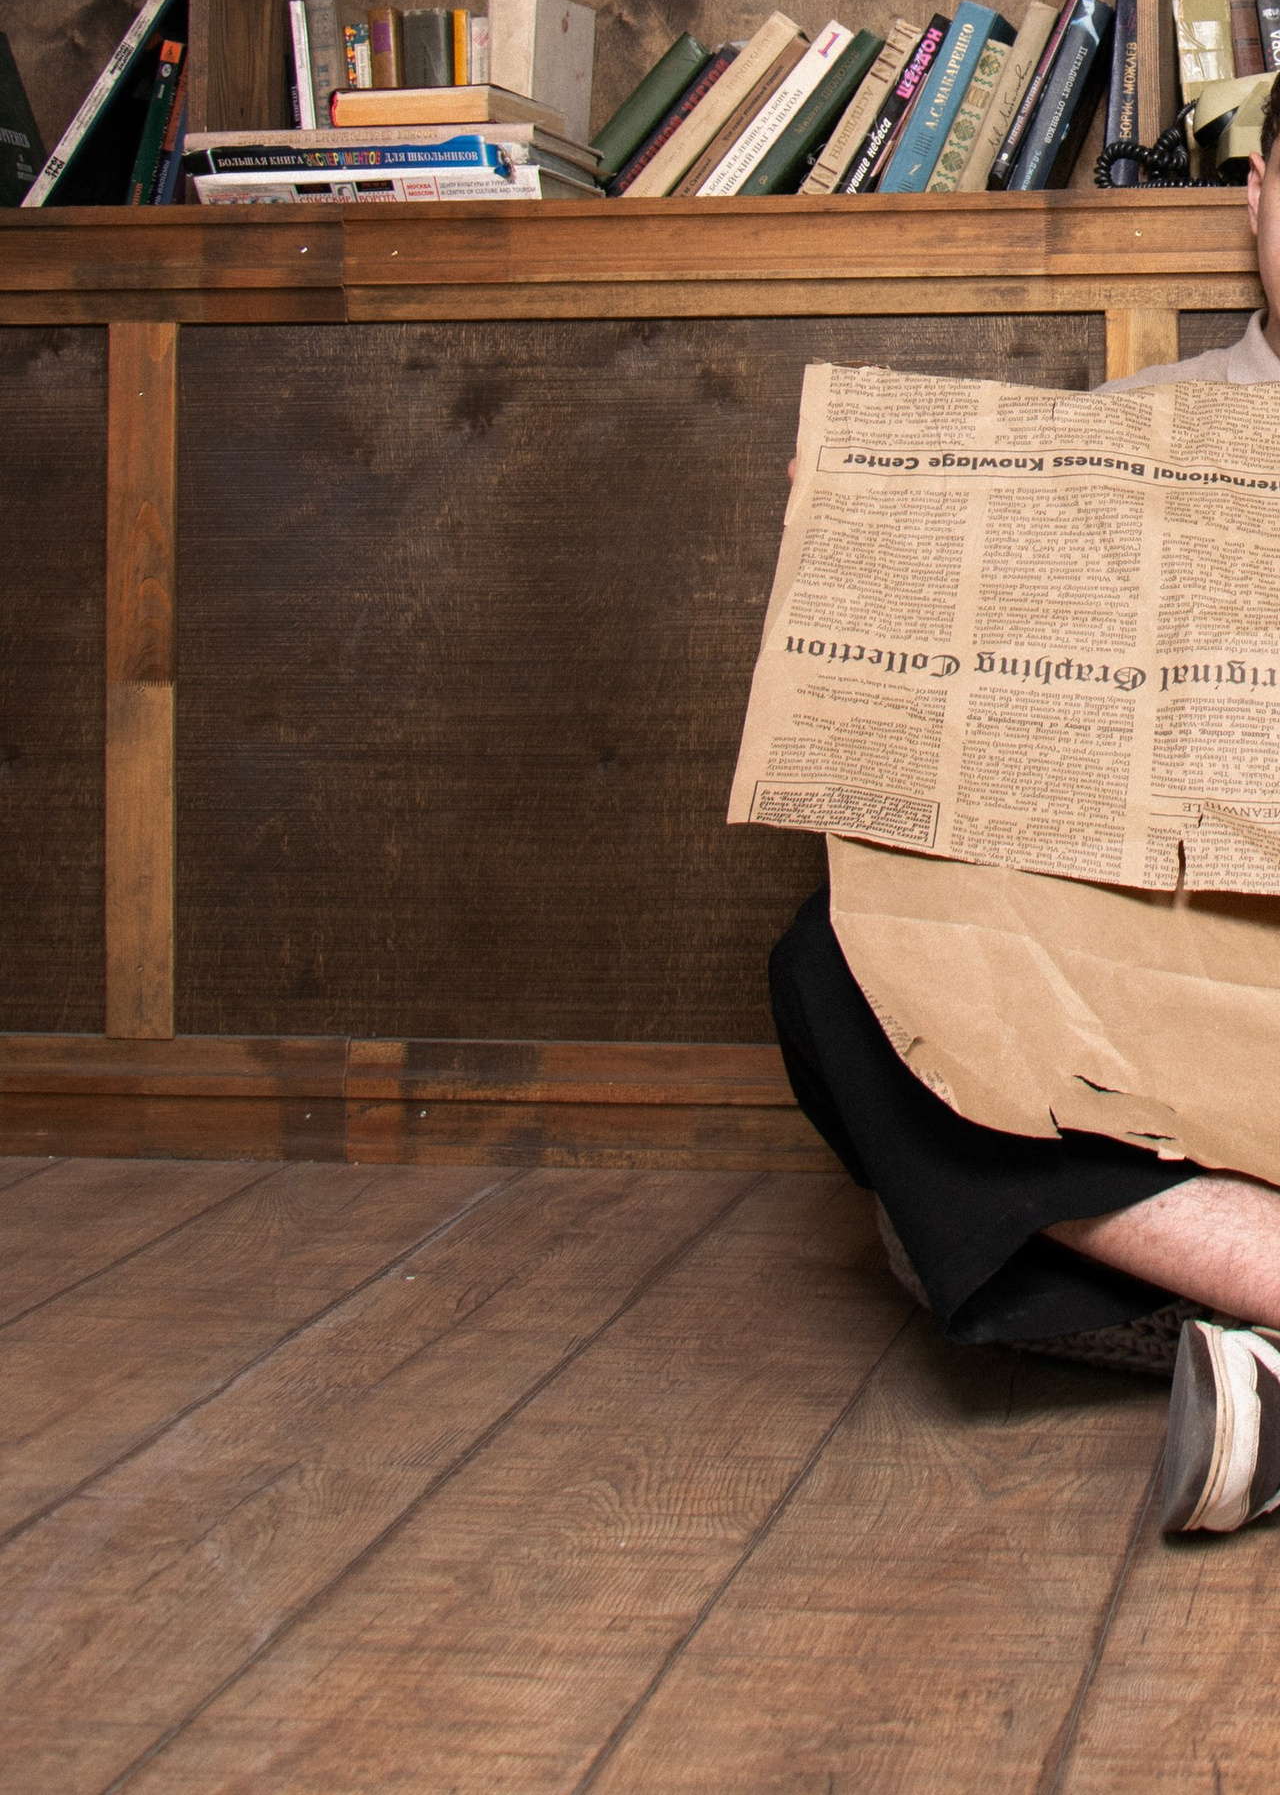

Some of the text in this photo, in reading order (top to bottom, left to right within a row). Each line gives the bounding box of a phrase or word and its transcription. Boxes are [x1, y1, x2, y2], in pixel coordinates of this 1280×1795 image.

[919, 21, 981, 130] А.С.МАКАРЕНКО
[1040, 45, 1090, 144] Пятьдесят оттенков
[1115, 41, 1140, 138] БОРИС МОЖАЕВ
[750, 88, 807, 155] ШАГ ЗА ШАГОМ
[862, 116, 895, 158] небеса
[218, 149, 478, 167] БОЛЬШАЯ КНИГА ЭКСПЕРИМЕНТОВ ДЛЯ ШКОЛЬНИКОВ
[406, 181, 432, 189] МОСКВА
[844, 453, 920, 470] Center
[928, 454, 1044, 472] Knowlage
[1053, 455, 1145, 476] Busness
[784, 636, 960, 678] Collection
[974, 651, 1146, 691] Graphing
